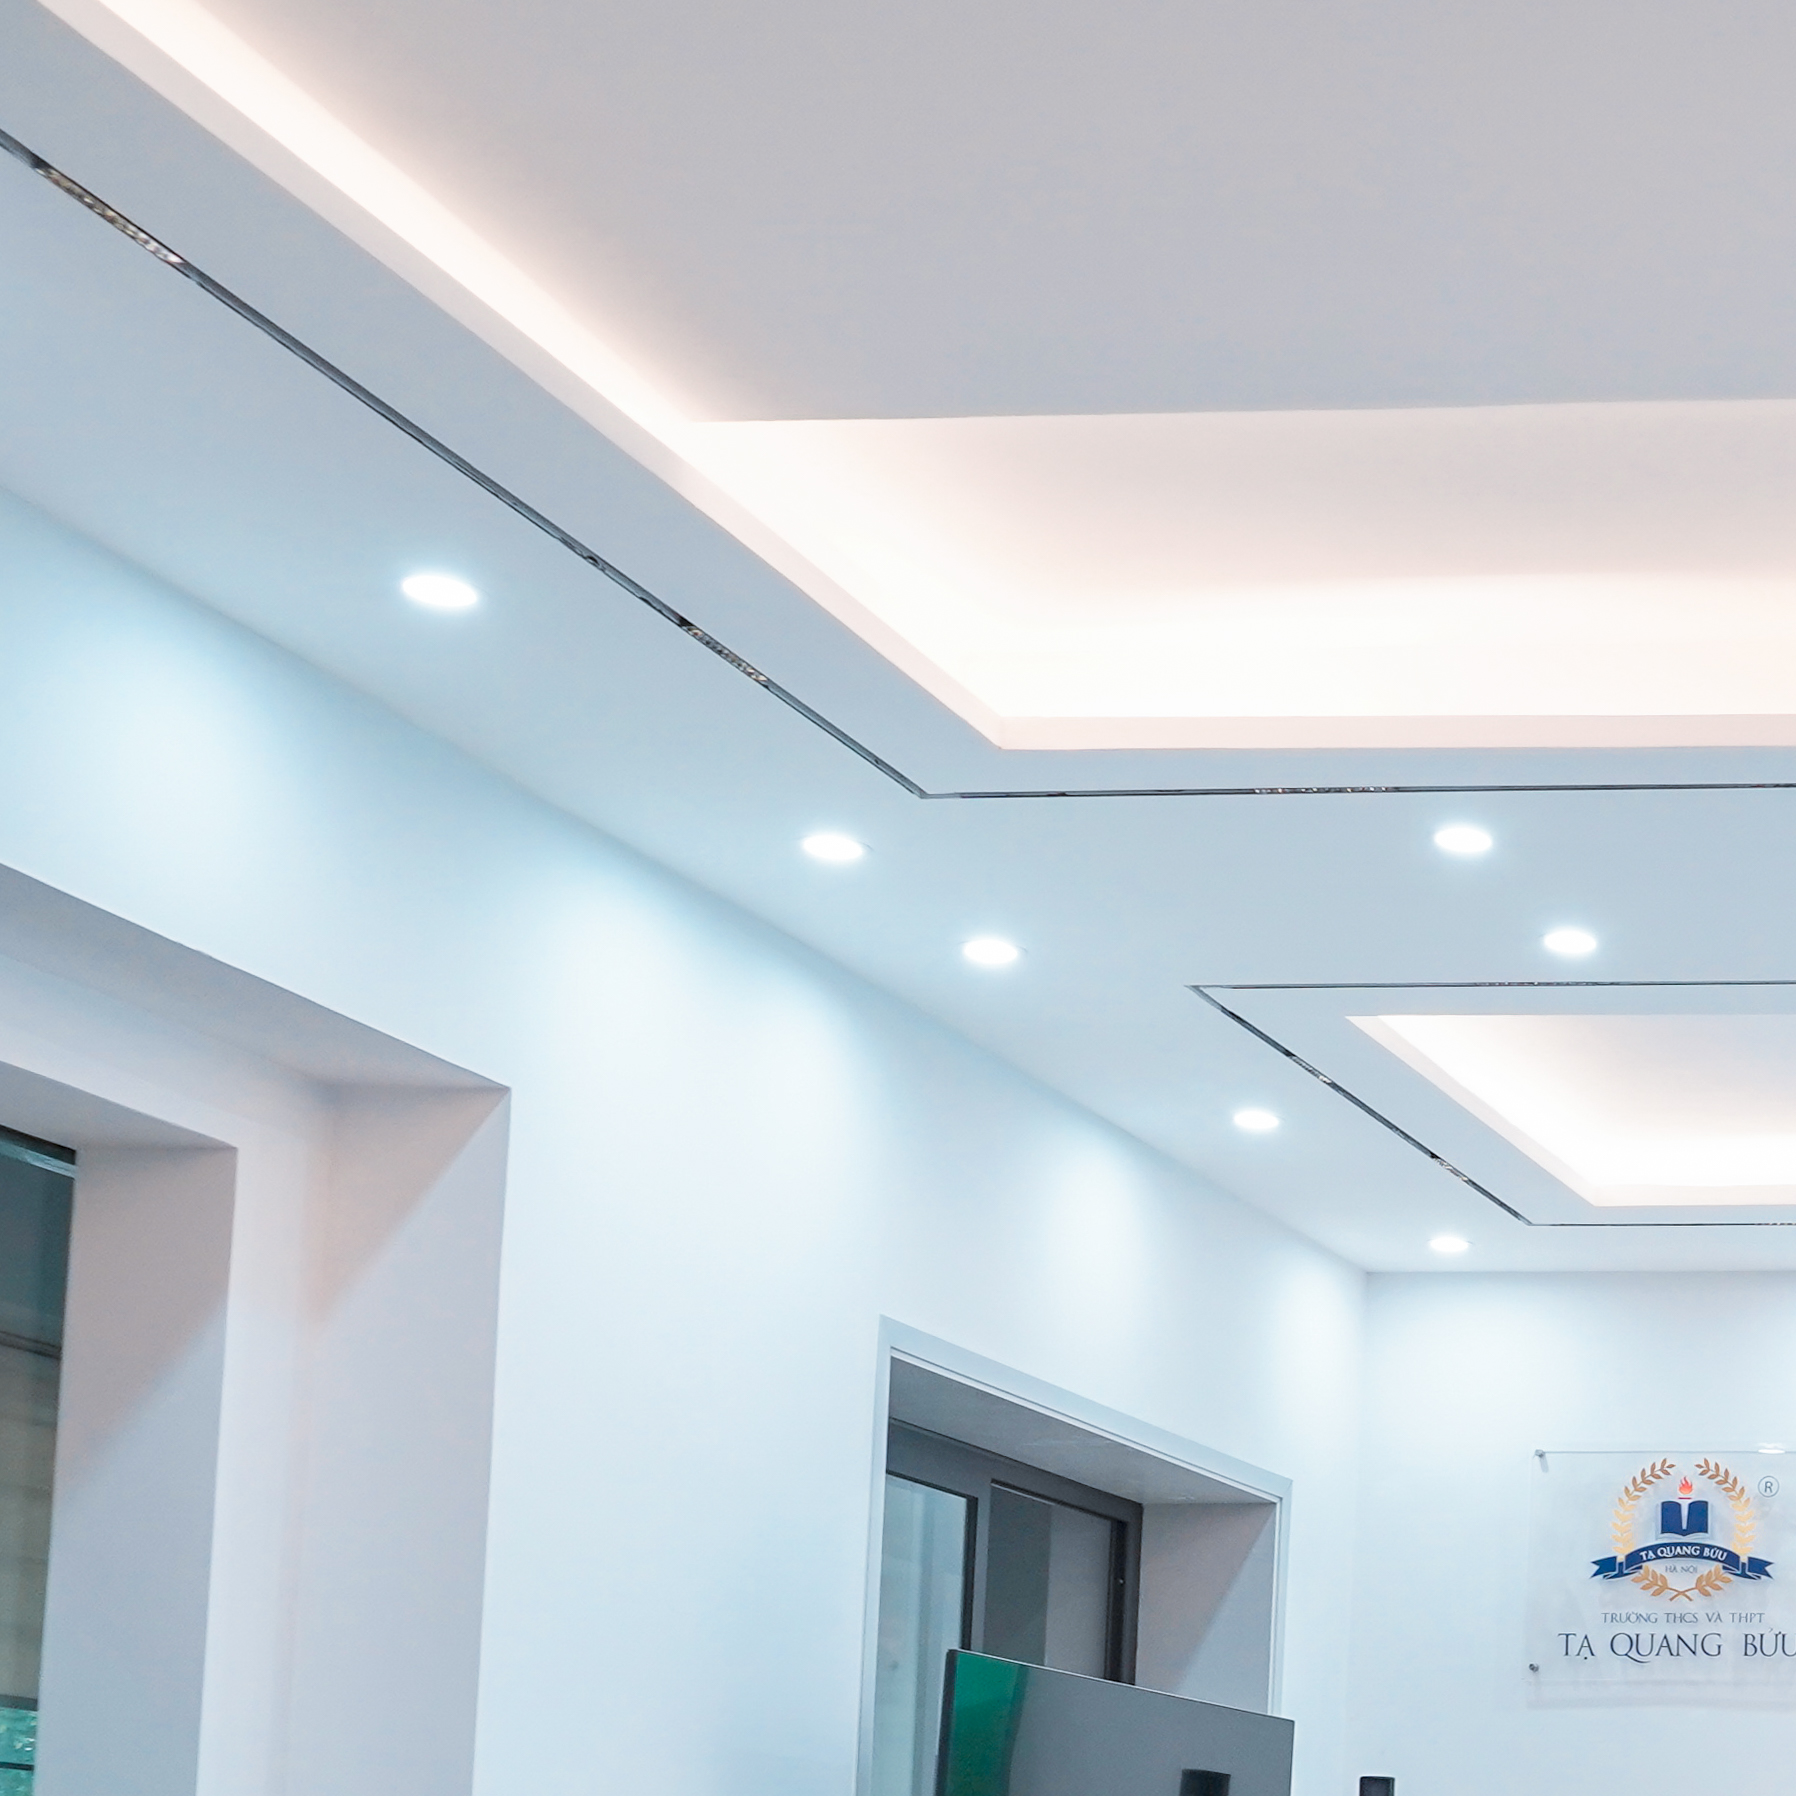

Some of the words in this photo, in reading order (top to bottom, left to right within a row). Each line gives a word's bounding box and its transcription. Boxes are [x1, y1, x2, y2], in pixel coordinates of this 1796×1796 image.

[1657, 1545, 1700, 1558] QUANG
[1601, 1611, 1658, 1624] TRƯỜNG
[1664, 1612, 1698, 1624] THCS
[1705, 1611, 1724, 1623] VÀ
[1729, 1612, 1765, 1623] THPT
[1558, 1633, 1596, 1660] TẠ
[1609, 1632, 1723, 1664] QUANG
